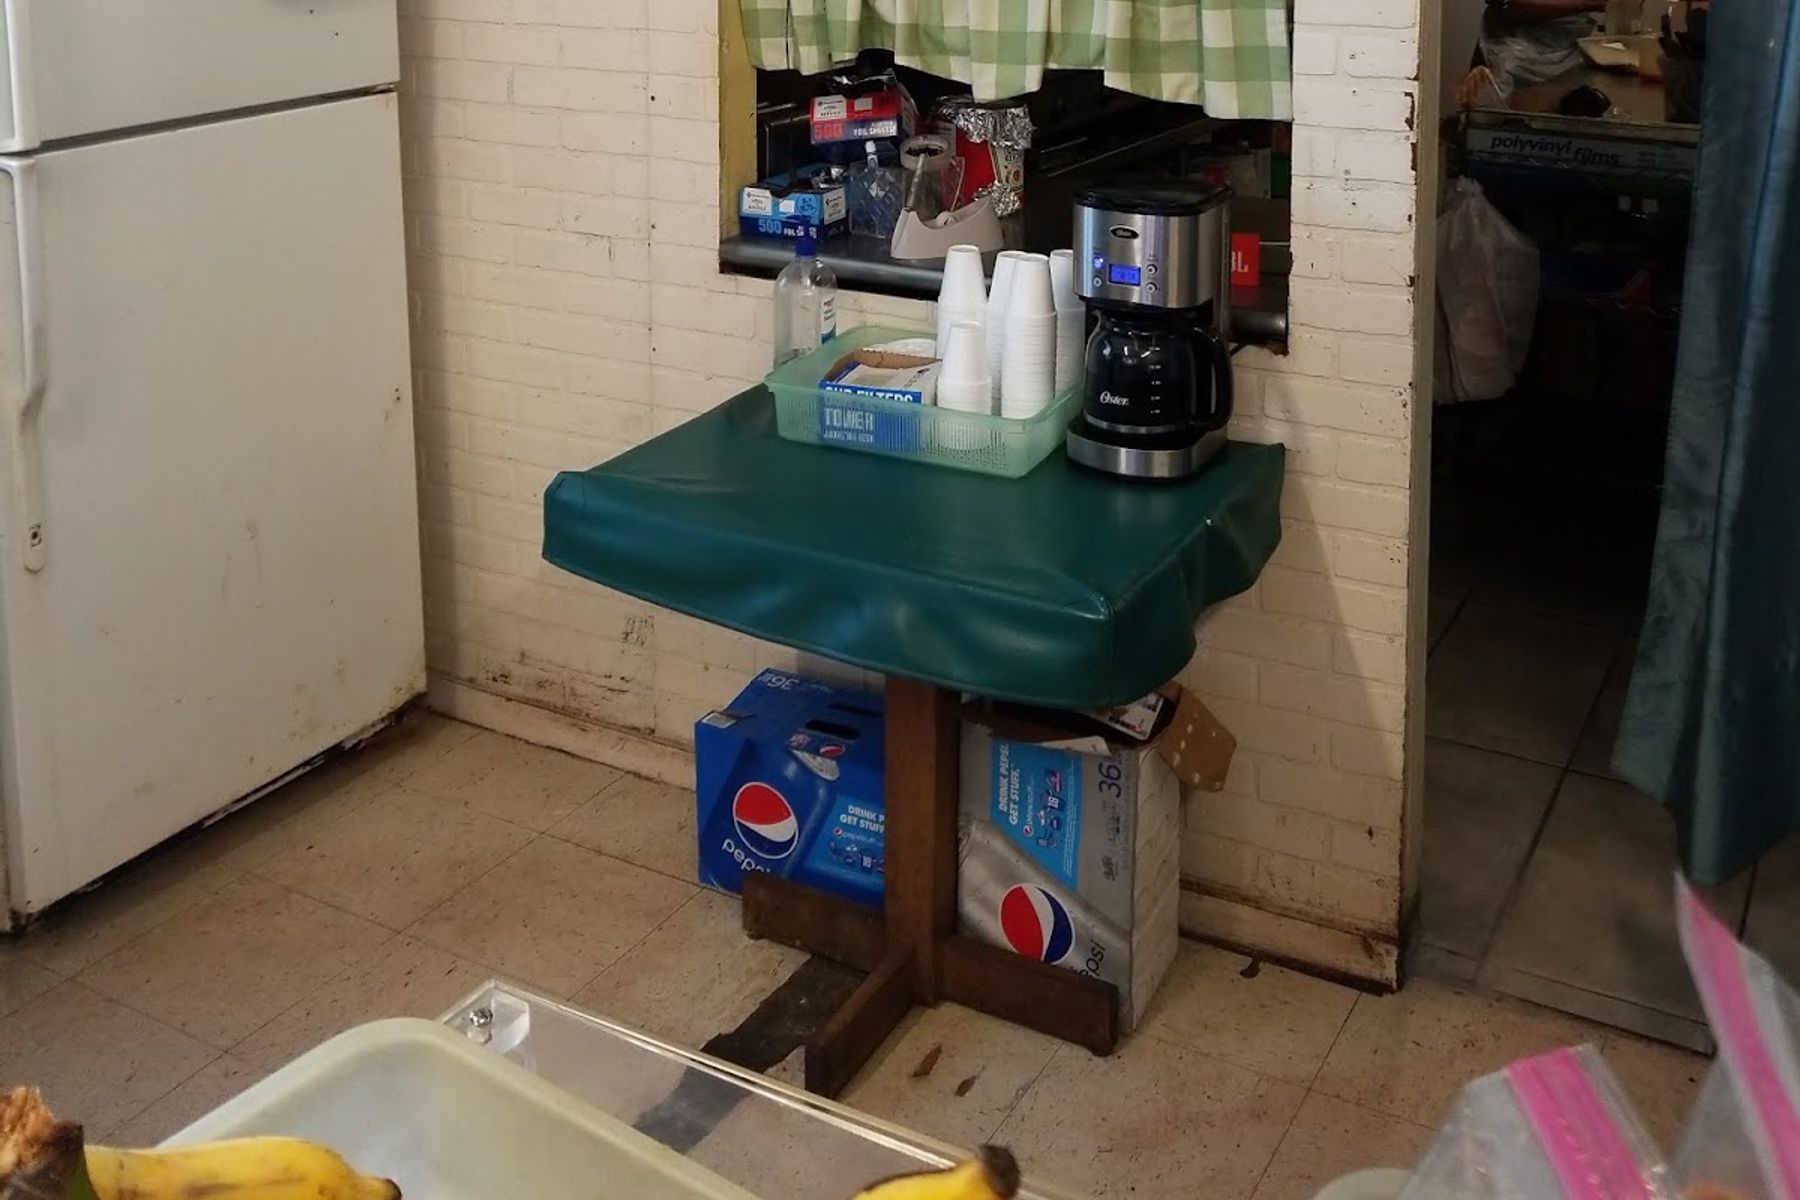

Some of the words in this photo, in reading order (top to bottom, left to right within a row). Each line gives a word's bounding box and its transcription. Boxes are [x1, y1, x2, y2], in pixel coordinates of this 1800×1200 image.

[813, 122, 843, 139] 500
[1491, 133, 1571, 154] polyvinyl
[1573, 147, 1619, 167] films
[758, 219, 781, 234] 500
[1100, 391, 1130, 406] Oster
[1098, 762, 1122, 798] 36
[998, 777, 1009, 812] DRINK
[840, 814, 858, 826] GET
[848, 805, 877, 821] DRINK
[1008, 803, 1018, 826] GET
